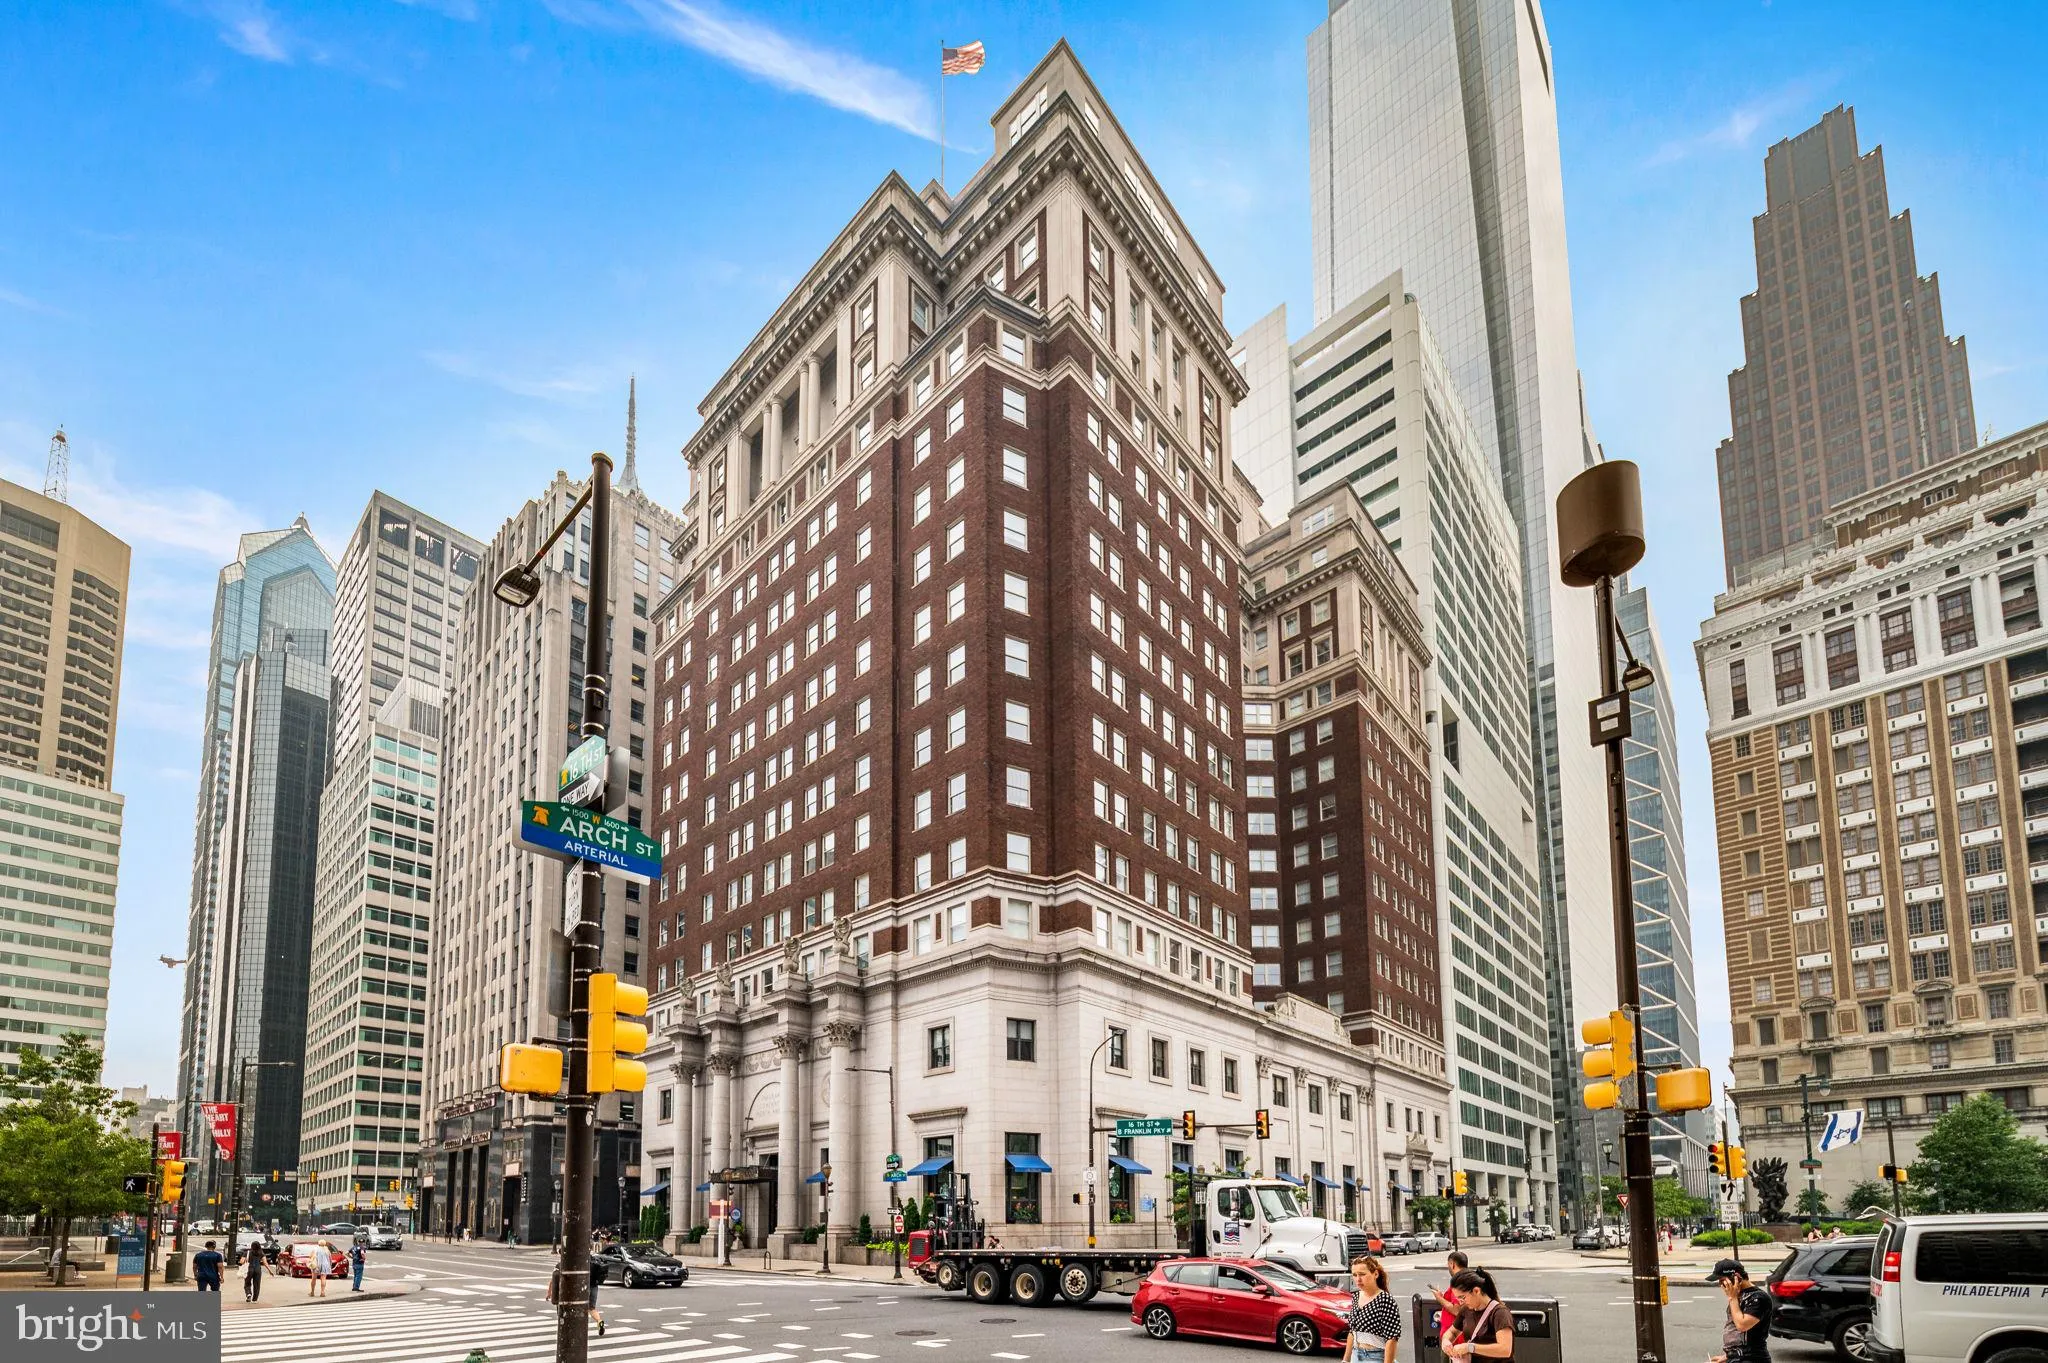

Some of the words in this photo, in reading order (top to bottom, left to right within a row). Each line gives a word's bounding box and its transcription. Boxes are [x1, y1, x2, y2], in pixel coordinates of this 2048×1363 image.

[569, 760, 578, 781] 16
[581, 750, 592, 773] TH
[594, 746, 603, 762] ST
[577, 781, 590, 801] WAY
[572, 808, 589, 820] 1500
[592, 814, 600, 825] W
[604, 819, 620, 830] 1600
[560, 816, 627, 852] ARCH
[635, 842, 653, 857] ST
[564, 840, 628, 867] ARTERIAL
[204, 1105, 218, 1114] THE
[205, 1113, 229, 1122] HEART
[272, 1194, 293, 1202] PNC
[1942, 1284, 2030, 1298] PHILADELPHIA
